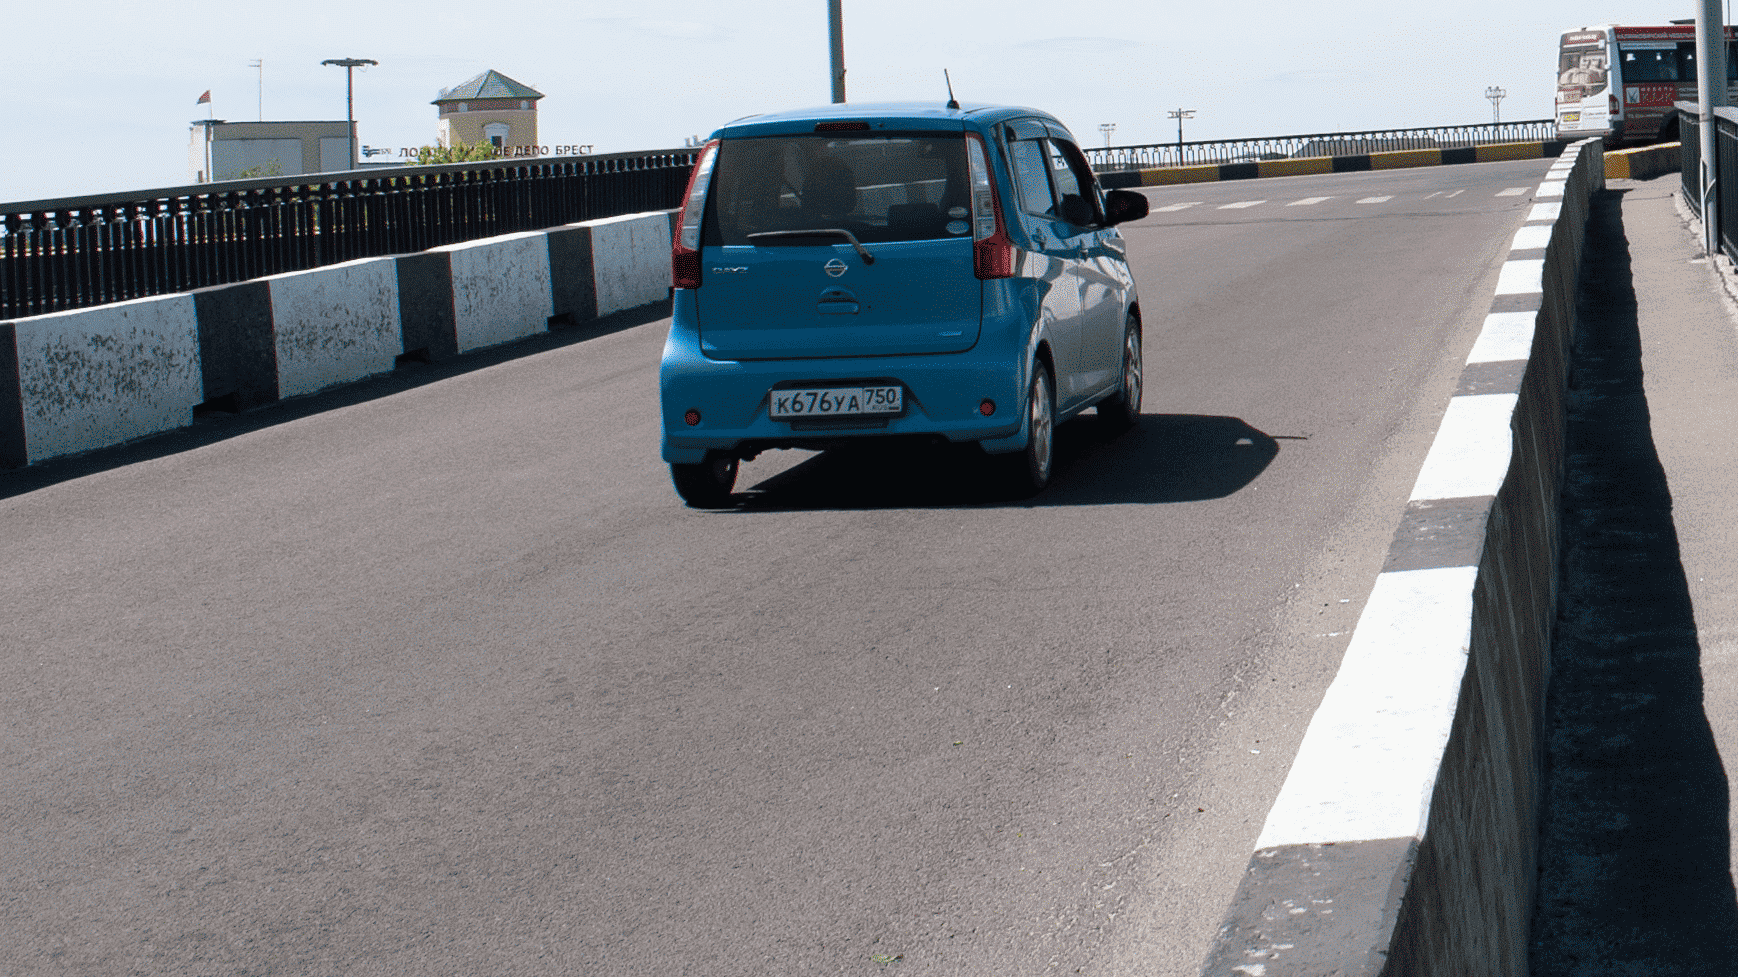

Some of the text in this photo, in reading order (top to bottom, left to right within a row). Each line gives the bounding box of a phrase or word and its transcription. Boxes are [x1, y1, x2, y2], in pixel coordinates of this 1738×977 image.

[514, 145, 550, 157] ДЕПО
[555, 144, 594, 156] БРЕСТ
[865, 388, 896, 406] 750
